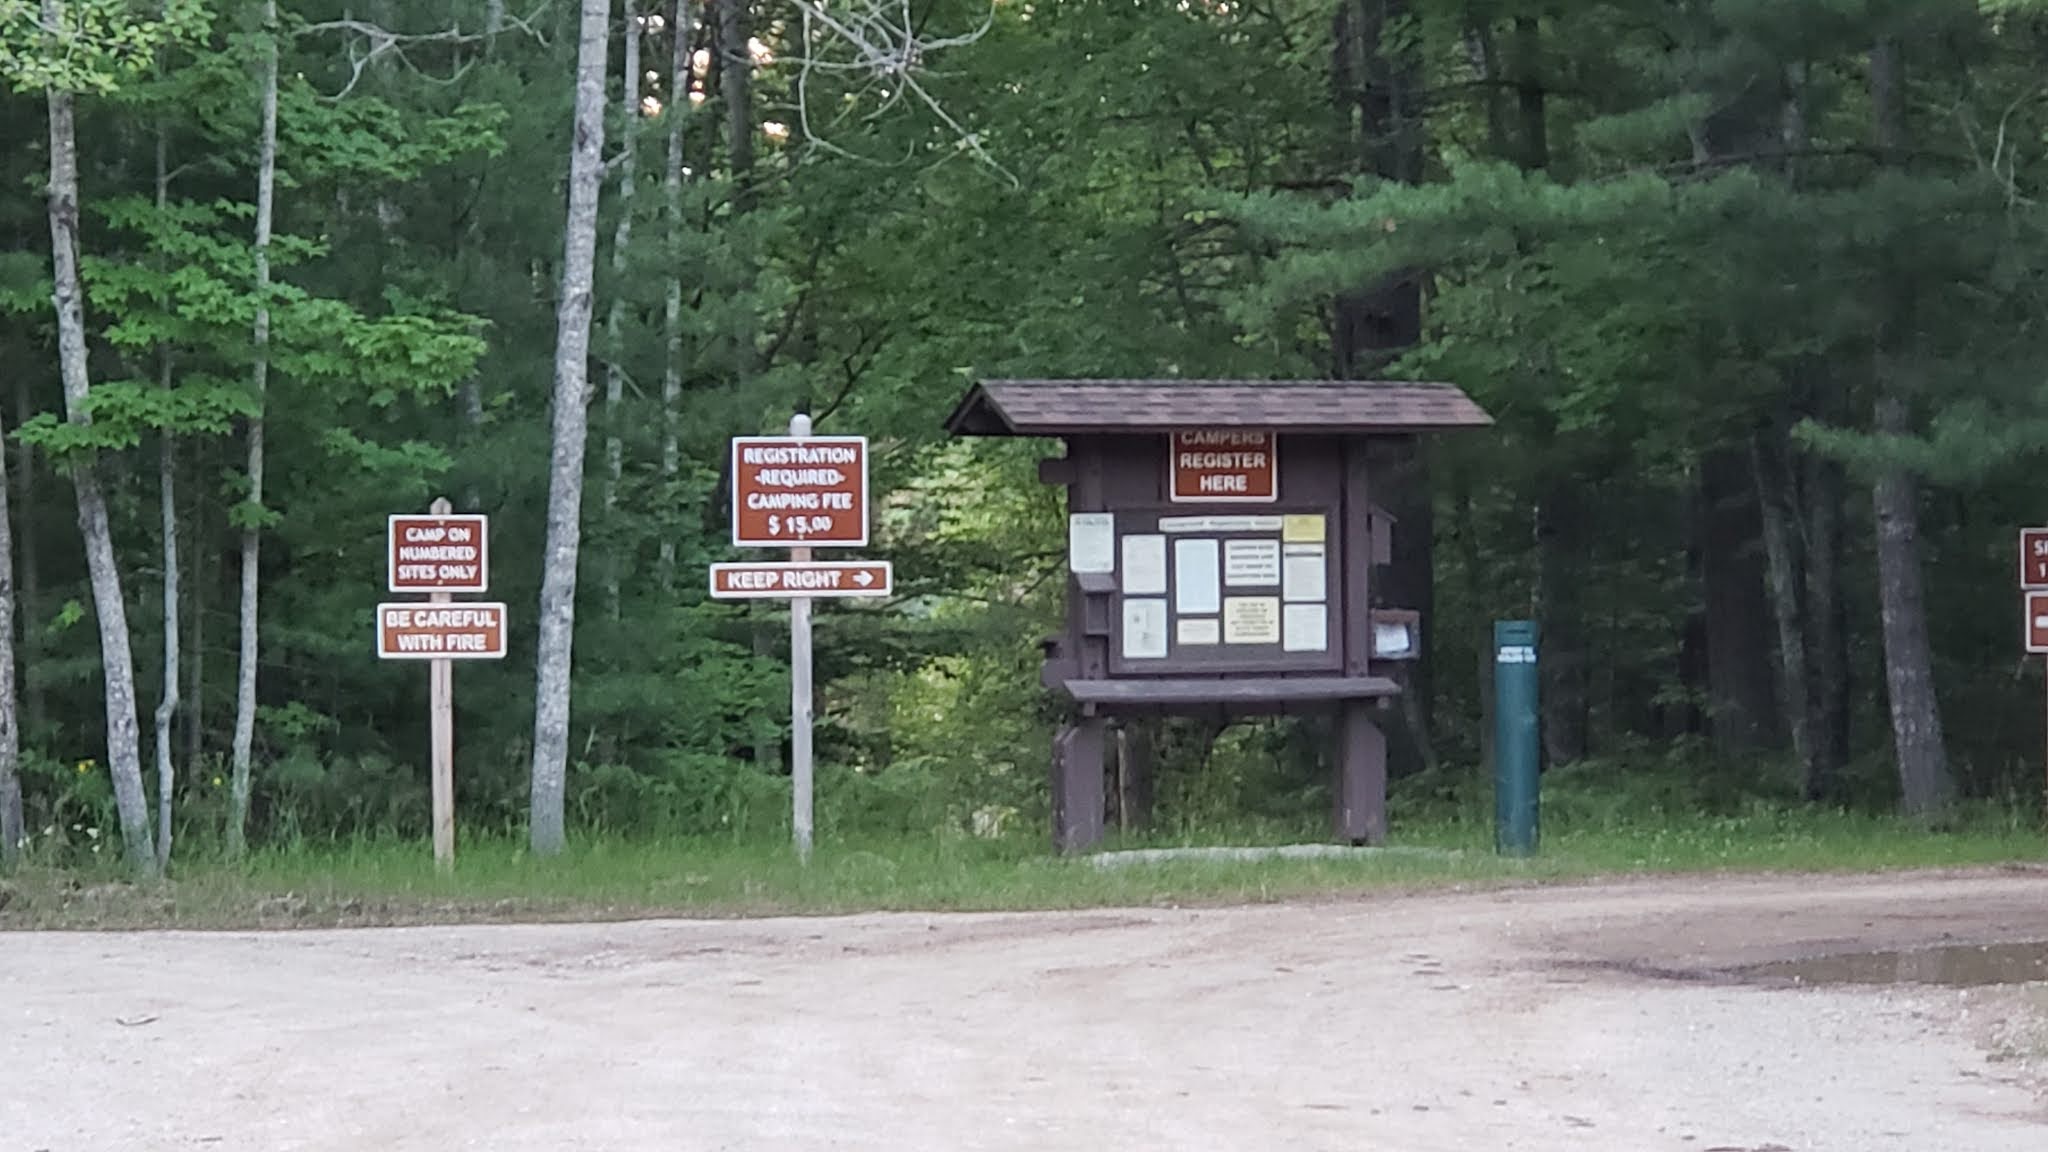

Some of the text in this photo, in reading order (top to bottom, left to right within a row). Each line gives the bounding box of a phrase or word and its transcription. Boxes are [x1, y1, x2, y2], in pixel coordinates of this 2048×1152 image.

[744, 448, 856, 464] REGISTRATION
[1180, 452, 1266, 469] REGISTER
[1200, 474, 1248, 492] HERE
[747, 493, 853, 509] CAMPING FEE
[768, 515, 833, 536] $ 15.00
[405, 527, 472, 542] CAMP ON
[399, 546, 477, 561] NUMBERED
[398, 565, 478, 580] SITES ONLY
[727, 570, 842, 589] KEEP RIGHT
[386, 610, 497, 627] BE CAREFUL
[397, 634, 487, 650] WITH FIRE
